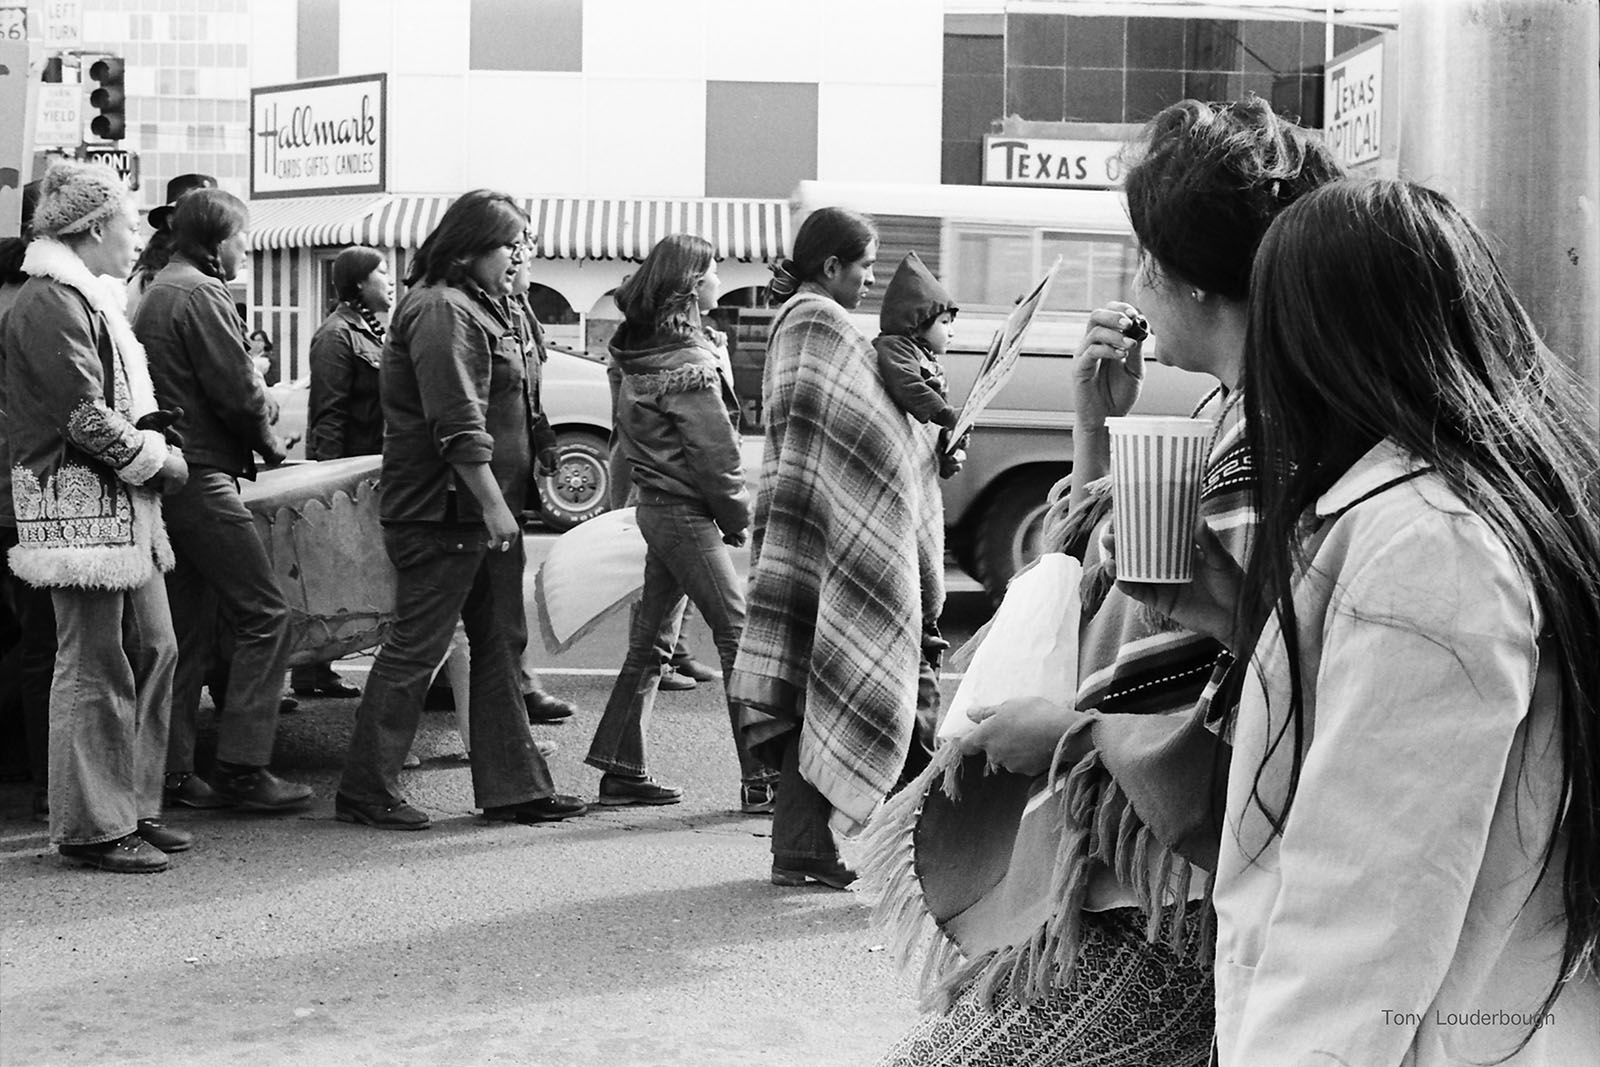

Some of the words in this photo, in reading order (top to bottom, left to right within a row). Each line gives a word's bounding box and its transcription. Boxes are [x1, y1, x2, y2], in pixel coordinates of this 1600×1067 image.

[48, 3, 76, 19] LEFT
[48, 25, 77, 40] TURN
[43, 110, 75, 122] YIELD
[257, 94, 377, 176] Hallmark
[1326, 106, 1378, 160] OPTICAL
[278, 158, 301, 179] CARDS
[305, 155, 329, 177] GIFTS
[335, 152, 374, 176] CANDLES
